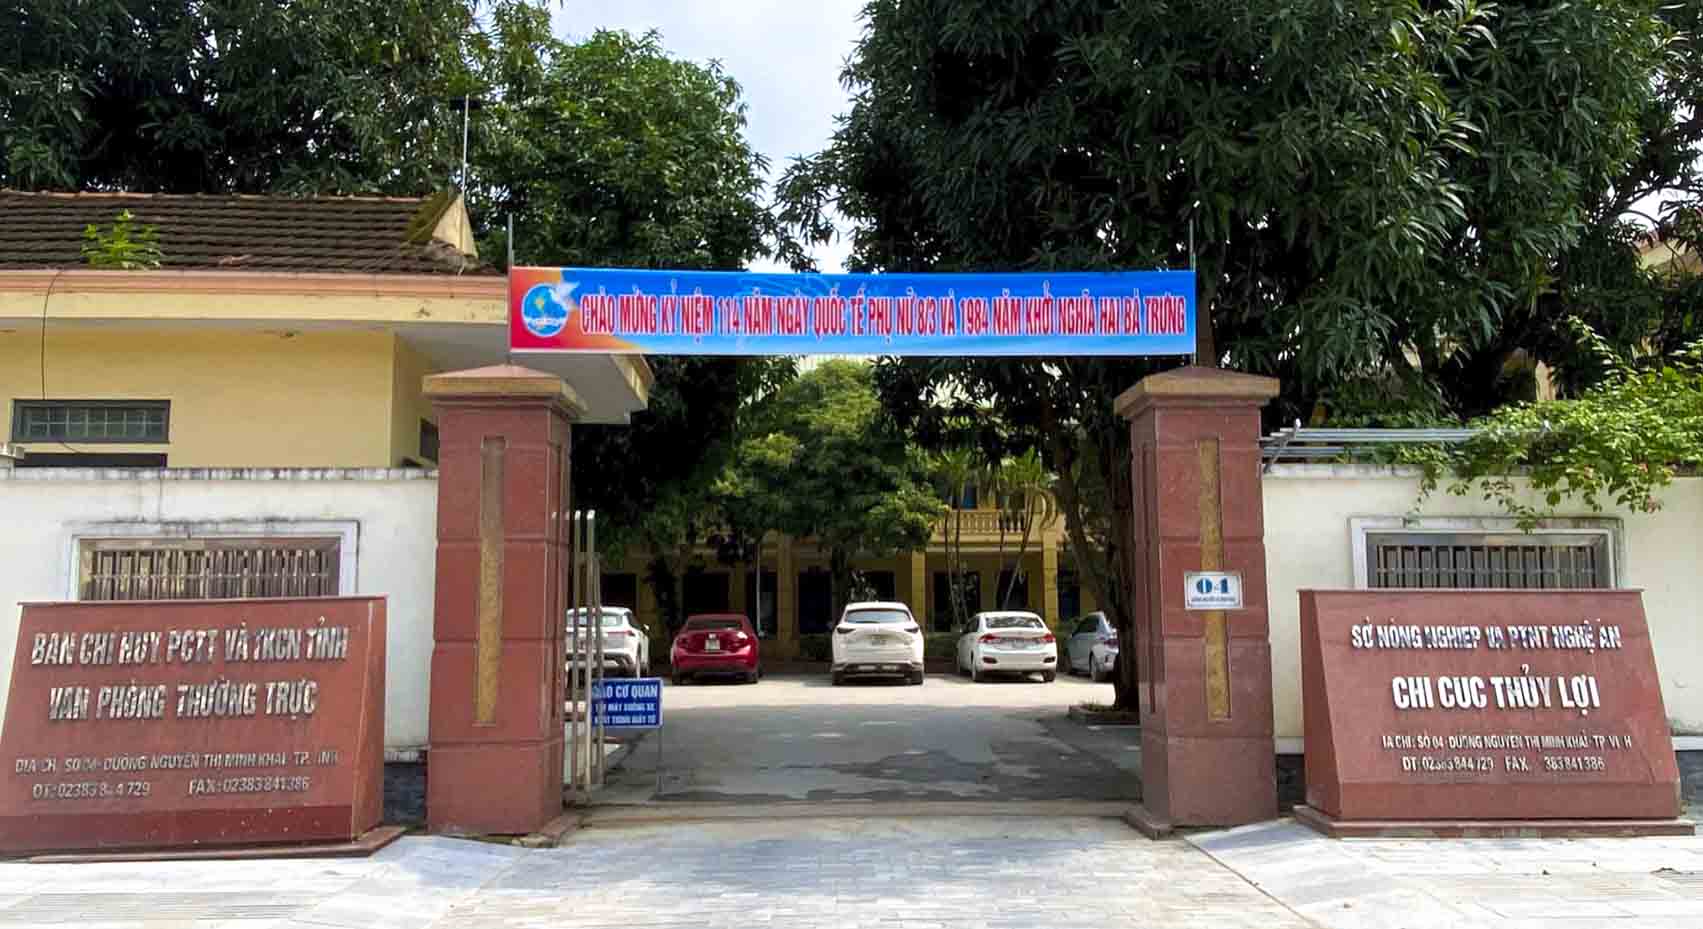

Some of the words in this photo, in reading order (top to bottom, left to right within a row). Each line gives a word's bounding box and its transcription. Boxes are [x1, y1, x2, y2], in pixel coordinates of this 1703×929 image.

[580, 285, 615, 335] CHÀO
[618, 284, 657, 335] MỪNG
[661, 279, 679, 335] KỶ
[680, 287, 714, 343] NIỆM
[718, 296, 742, 335] 114
[743, 286, 773, 335] NĂM
[776, 287, 810, 335] NGÀY
[813, 282, 847, 342] QUỐC
[850, 282, 866, 336] TẾ
[868, 296, 893, 344] PHỤ
[896, 286, 916, 336] NỮ
[917, 296, 937, 336] 8/3
[940, 289, 957, 336] VÀ
[959, 296, 990, 336] 1984
[992, 288, 1021, 336] NĂM
[1025, 280, 1055, 336] KHỞI
[1058, 288, 1097, 336] NGHĨA
[1099, 296, 1121, 336] HAI
[1123, 288, 1141, 336] BÀ
[1144, 292, 1186, 336] TRƯNG
[31, 632, 76, 666] BAN
[118, 631, 163, 665] HUY
[166, 629, 219, 664] PCTT
[224, 621, 249, 662] VÀ
[305, 615, 349, 661] TỈNH
[1351, 615, 1374, 649] SỞ
[1507, 625, 1550, 649] PTNT
[1599, 624, 1623, 649] AN
[95, 679, 167, 720] PHÒNG
[176, 674, 257, 718] THƯỜNG
[265, 679, 318, 721] TRỰC
[631, 684, 658, 700] QUAN
[1392, 676, 1434, 709] CHI
[1490, 663, 1552, 709] THỦY
[1558, 674, 1601, 716] LỢI
